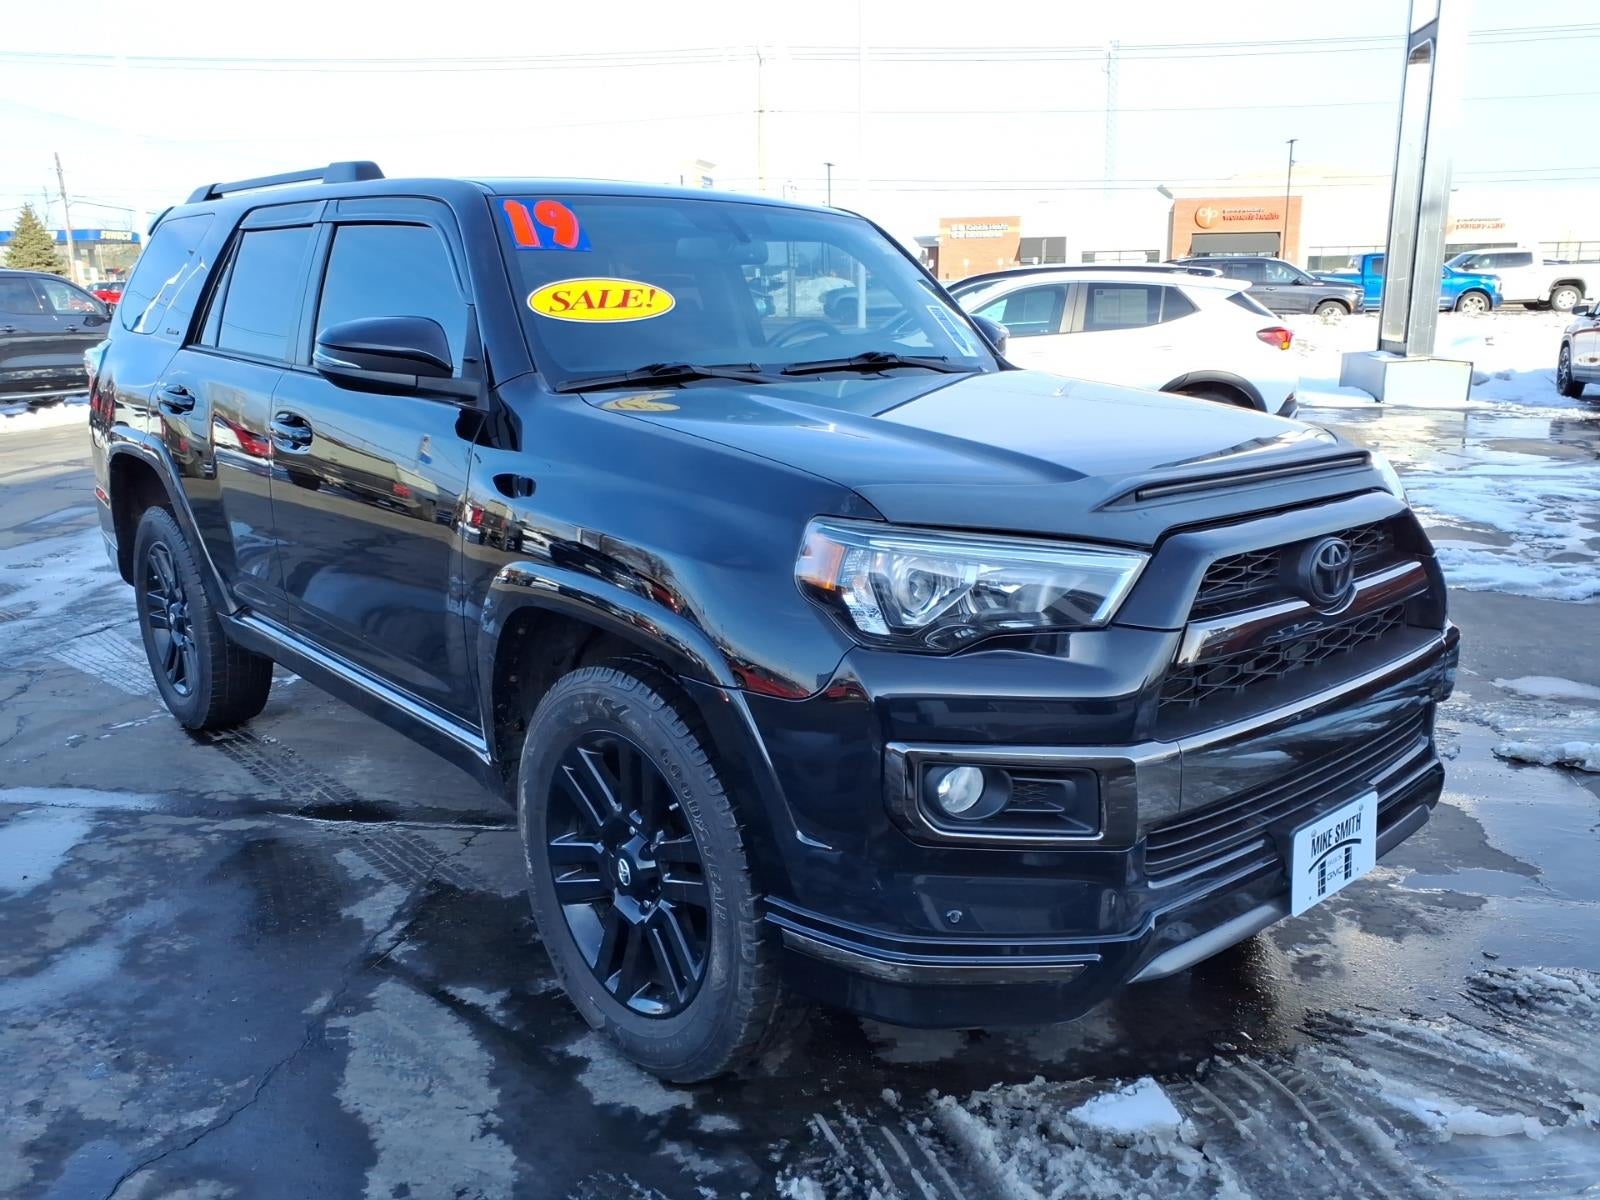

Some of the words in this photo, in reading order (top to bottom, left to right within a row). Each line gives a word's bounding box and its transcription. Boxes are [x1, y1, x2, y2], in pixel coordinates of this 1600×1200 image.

[503, 200, 580, 249] 19
[550, 288, 656, 313] SALE!
[1311, 828, 1332, 858] MIKE
[1335, 812, 1361, 843] SMITH
[1327, 865, 1343, 881] GMC
